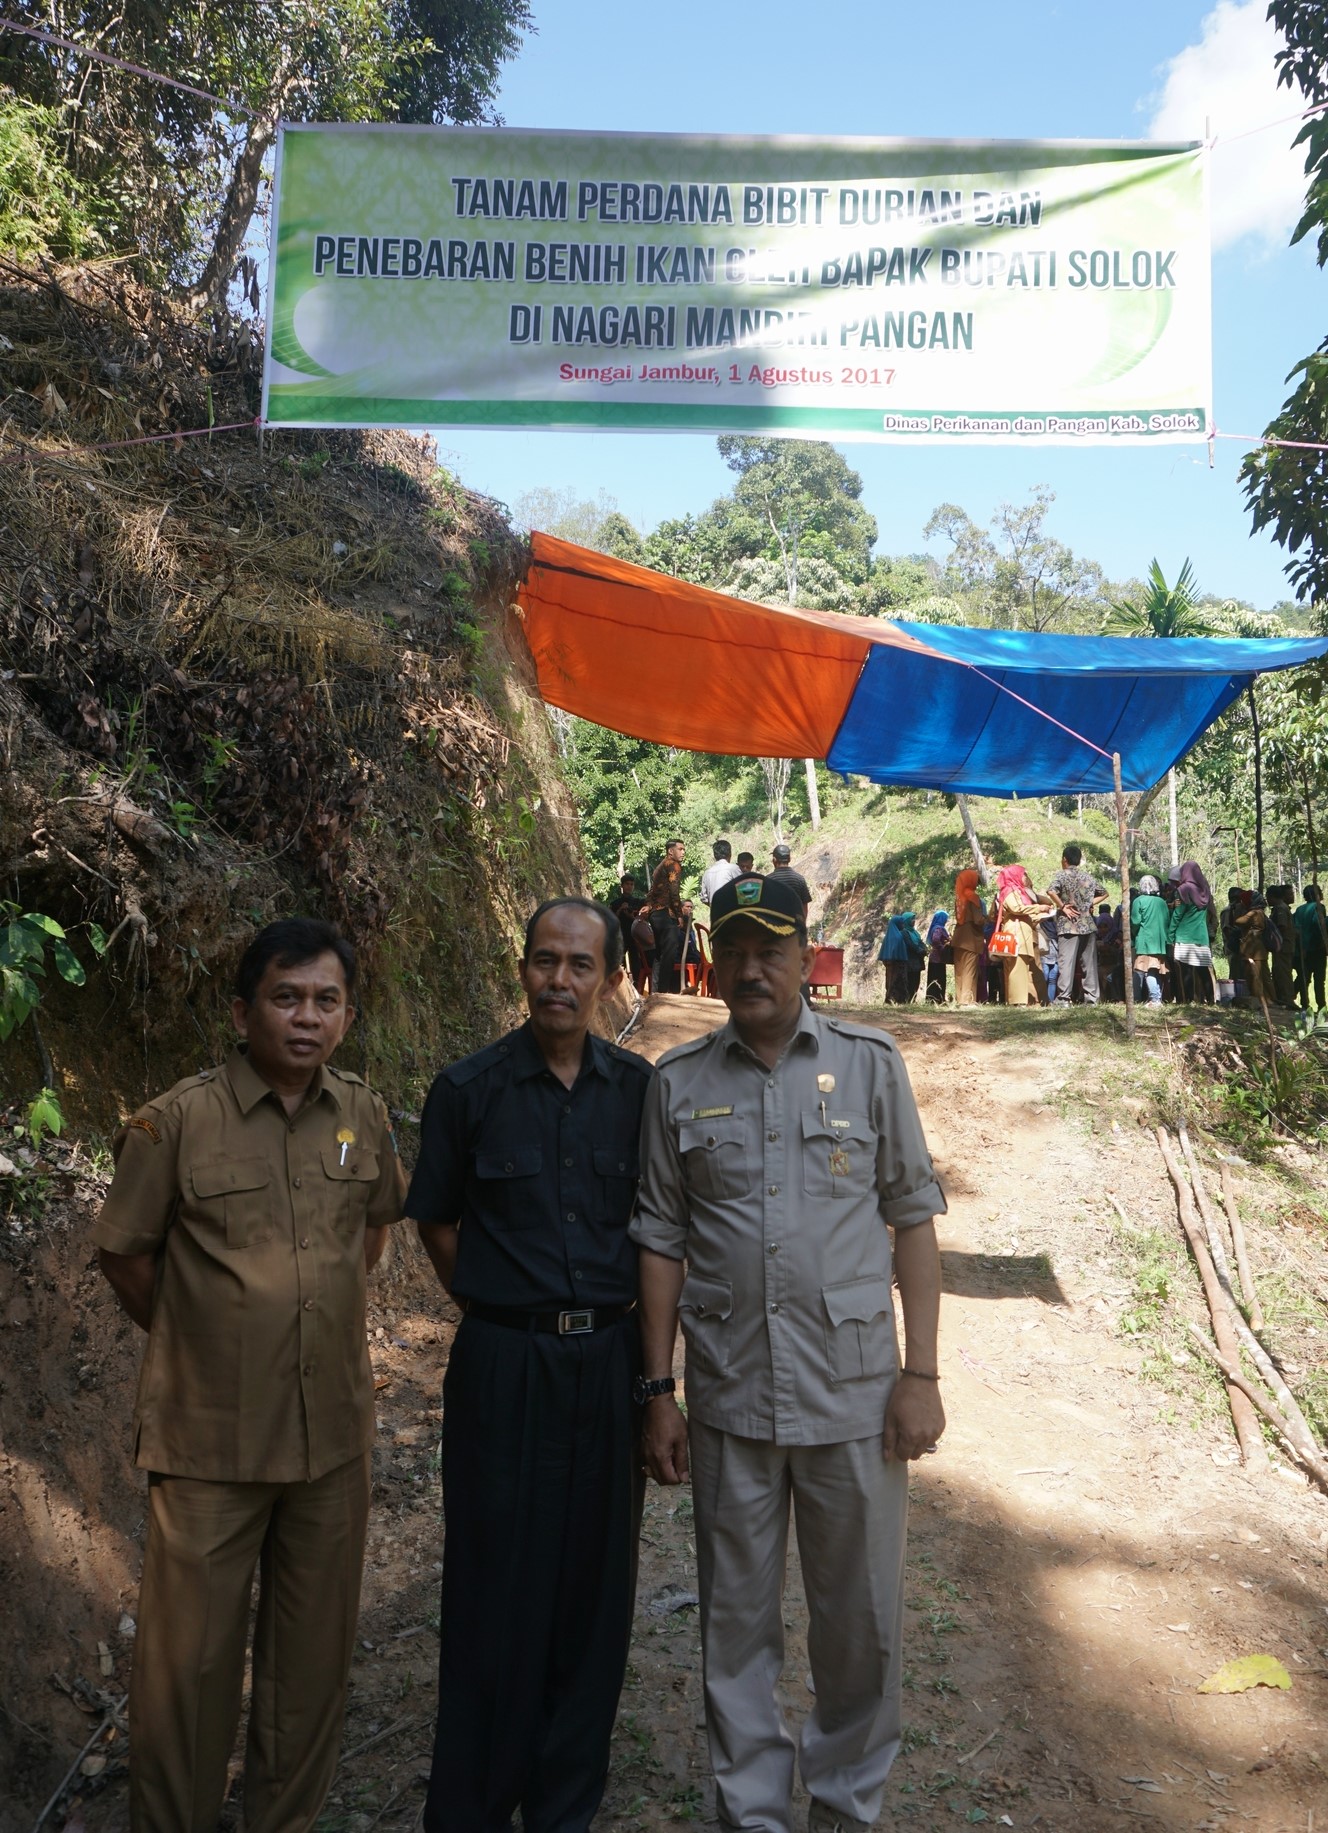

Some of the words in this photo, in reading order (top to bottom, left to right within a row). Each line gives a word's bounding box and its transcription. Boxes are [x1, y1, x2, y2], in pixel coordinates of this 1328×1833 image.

[452, 178, 566, 219] TANAM
[578, 182, 732, 224] PERDANA
[743, 185, 829, 225] BIBIT
[839, 188, 962, 226] DURIAN
[973, 191, 1042, 227] DAN
[314, 236, 513, 280] PENEBARAN
[525, 242, 625, 282] BENIH
[636, 245, 715, 283] IKAN
[820, 247, 933, 287] BAPAK
[941, 249, 1056, 287] BUPATI
[1068, 250, 1178, 288] SOLOK
[510, 305, 541, 343] DI
[552, 306, 675, 347] NAGARI
[840, 311, 973, 350] PANGAN
[559, 363, 632, 384] Sungai
[638, 365, 721, 386] Jambur,
[728, 365, 742, 382] 1
[748, 365, 833, 387] Agustus
[840, 367, 896, 385] 2017
[885, 416, 928, 429] Dinas
[933, 417, 1010, 431] Perikanan
[1014, 418, 1043, 431] dan
[1048, 418, 1106, 433] Pangan
[1110, 416, 1146, 430] Kab.
[1151, 415, 1197, 428] Solok
